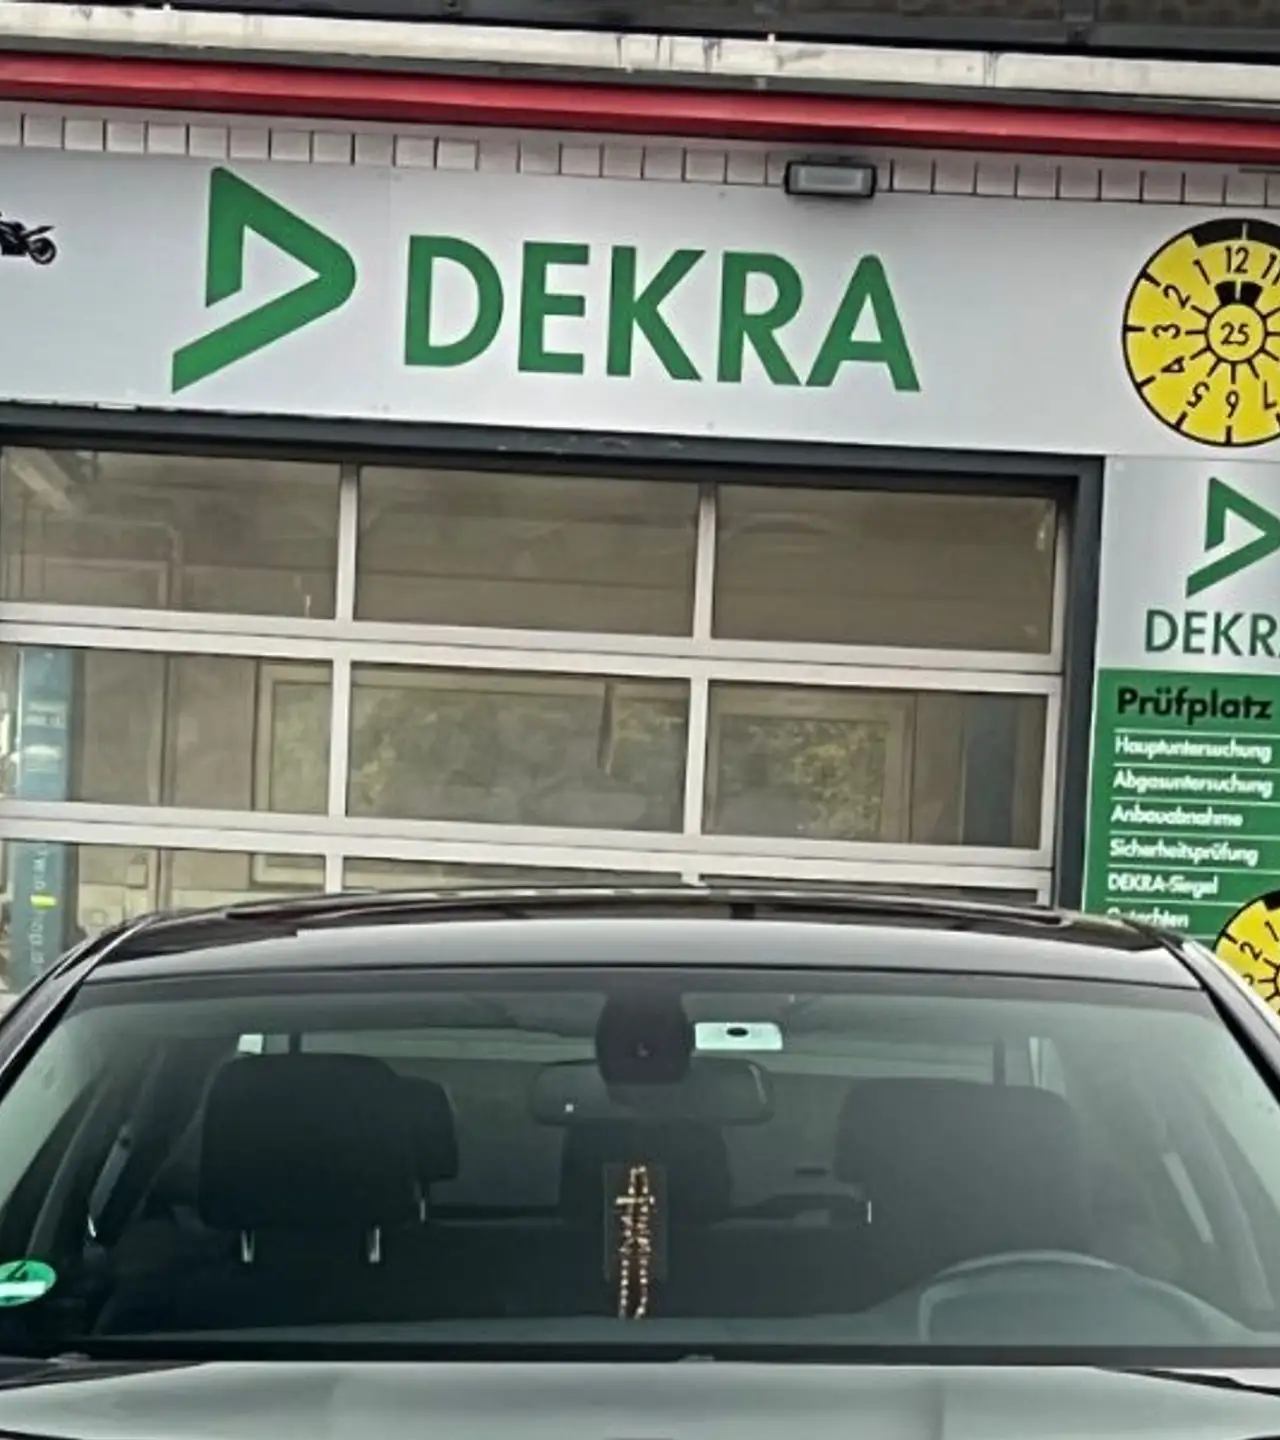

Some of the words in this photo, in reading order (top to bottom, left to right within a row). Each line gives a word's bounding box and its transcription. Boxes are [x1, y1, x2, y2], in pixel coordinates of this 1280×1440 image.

[1193, 259, 1210, 284] 1
[1224, 246, 1250, 274] 12
[1163, 285, 1190, 309] 2
[403, 234, 922, 393] DEKRA
[1152, 323, 1181, 339] 3
[1220, 322, 1251, 346] 25
[1161, 356, 1185, 374] 4
[1186, 382, 1210, 408] 5
[1226, 390, 1239, 419] 6
[1263, 380, 1277, 410] 7
[1117, 686, 1273, 725] Prüfplatz
[1115, 734, 1273, 765] Hauptuntersuchung
[1113, 769, 1274, 799] Abgasuntersuchung
[1111, 802, 1243, 827] Anbauabnahme
[1110, 838, 1259, 866] Sicherheitsprüfung
[1107, 872, 1219, 898] DEKRA-Siegel
[1264, 921, 1280, 942] 1
[1239, 941, 1263, 960] 2
